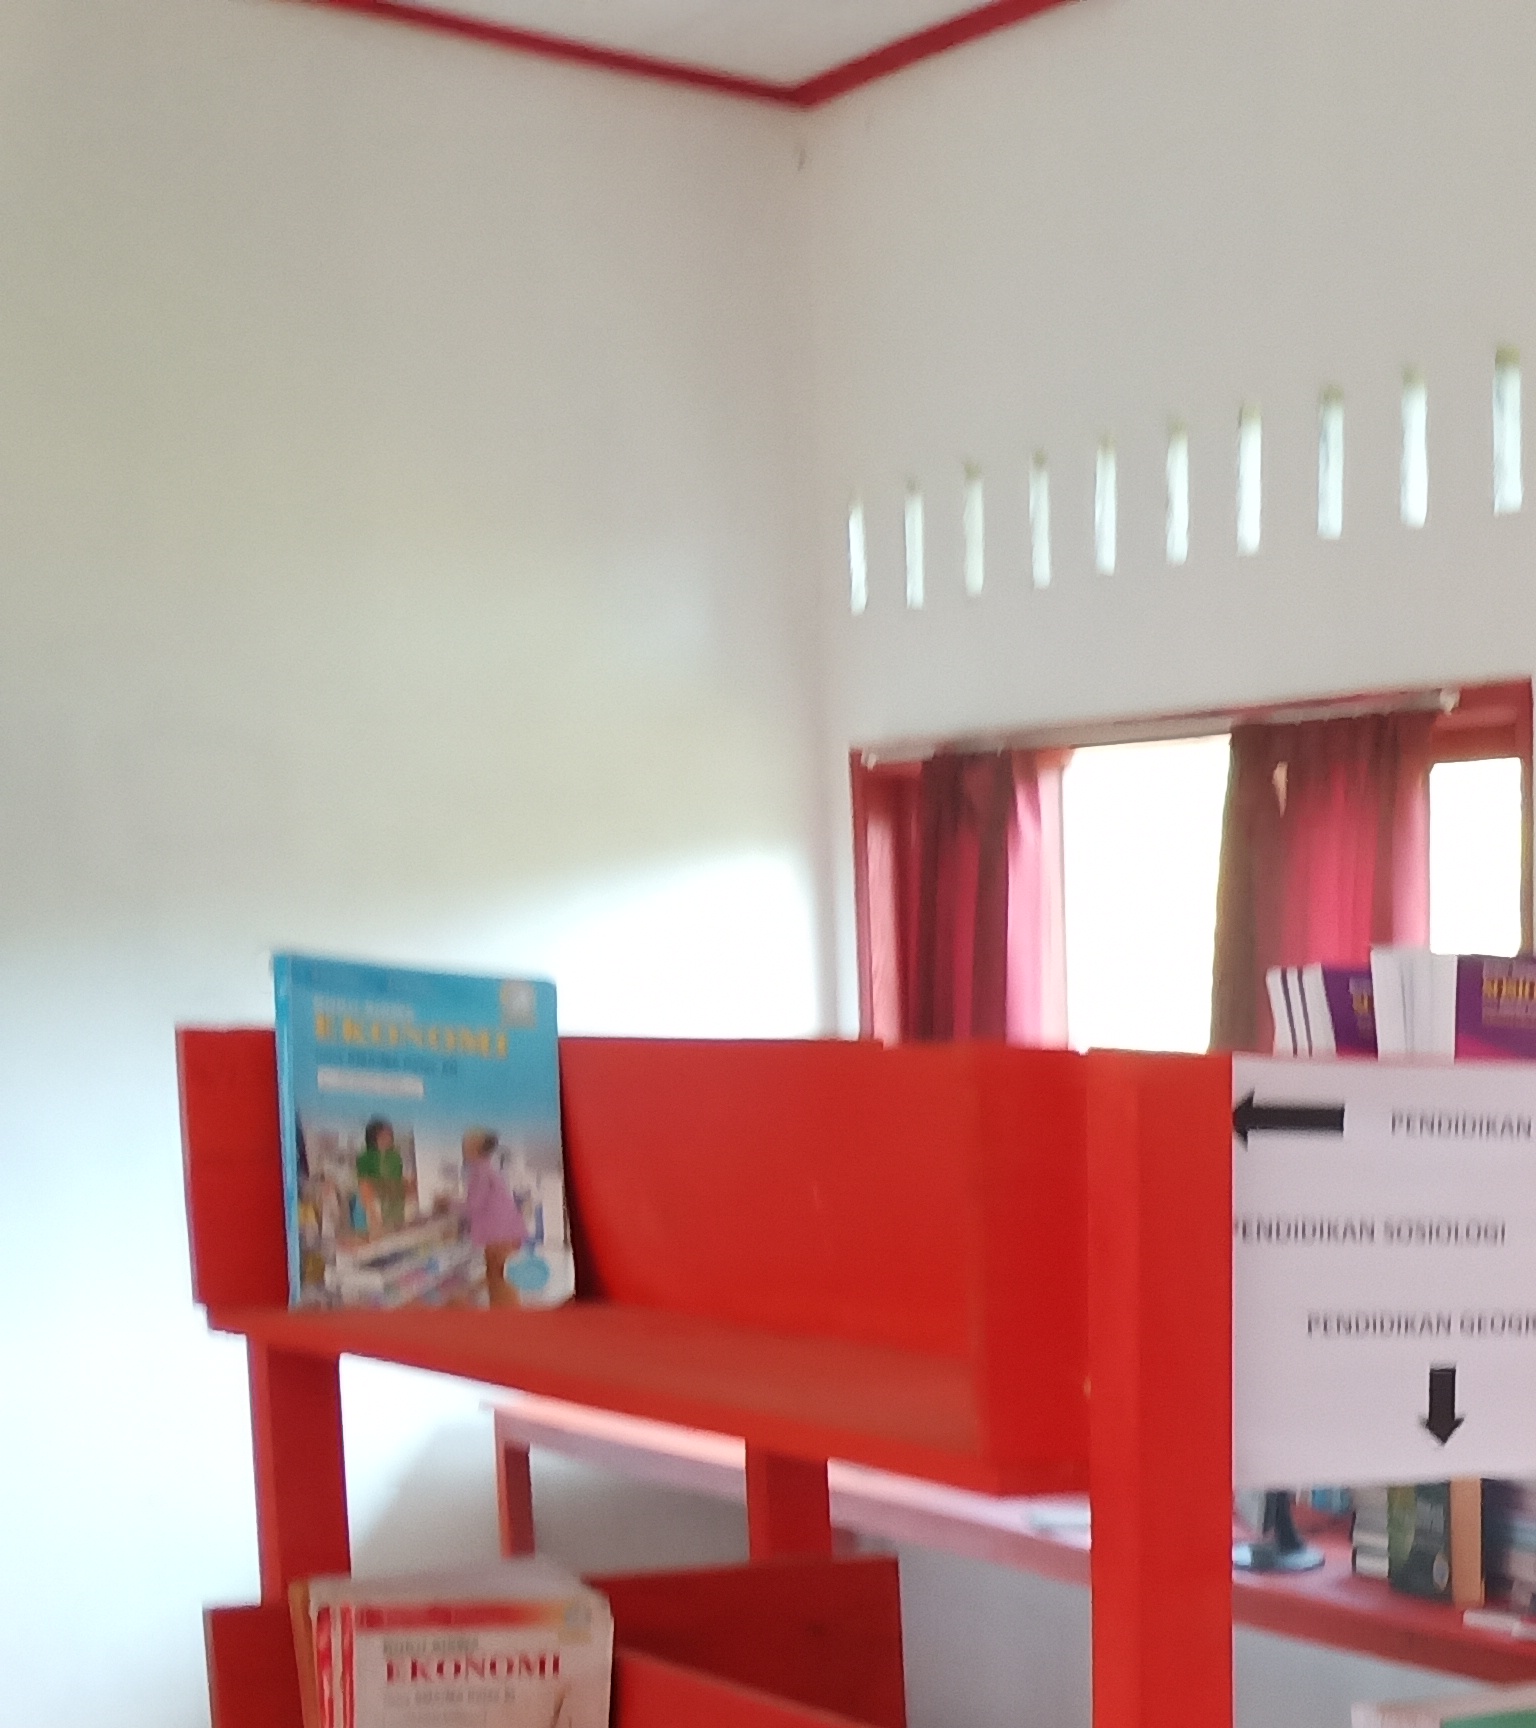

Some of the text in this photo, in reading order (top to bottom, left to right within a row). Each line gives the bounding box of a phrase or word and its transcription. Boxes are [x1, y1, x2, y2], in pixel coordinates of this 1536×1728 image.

[315, 1012, 508, 1061] EKONOMI
[1391, 1111, 1529, 1139] PENDIDIKAN
[1384, 1217, 1505, 1245] SOSIOLOGI
[1306, 1311, 1452, 1338] PENDIDIKAN
[386, 1654, 560, 1683] EKONOMI
